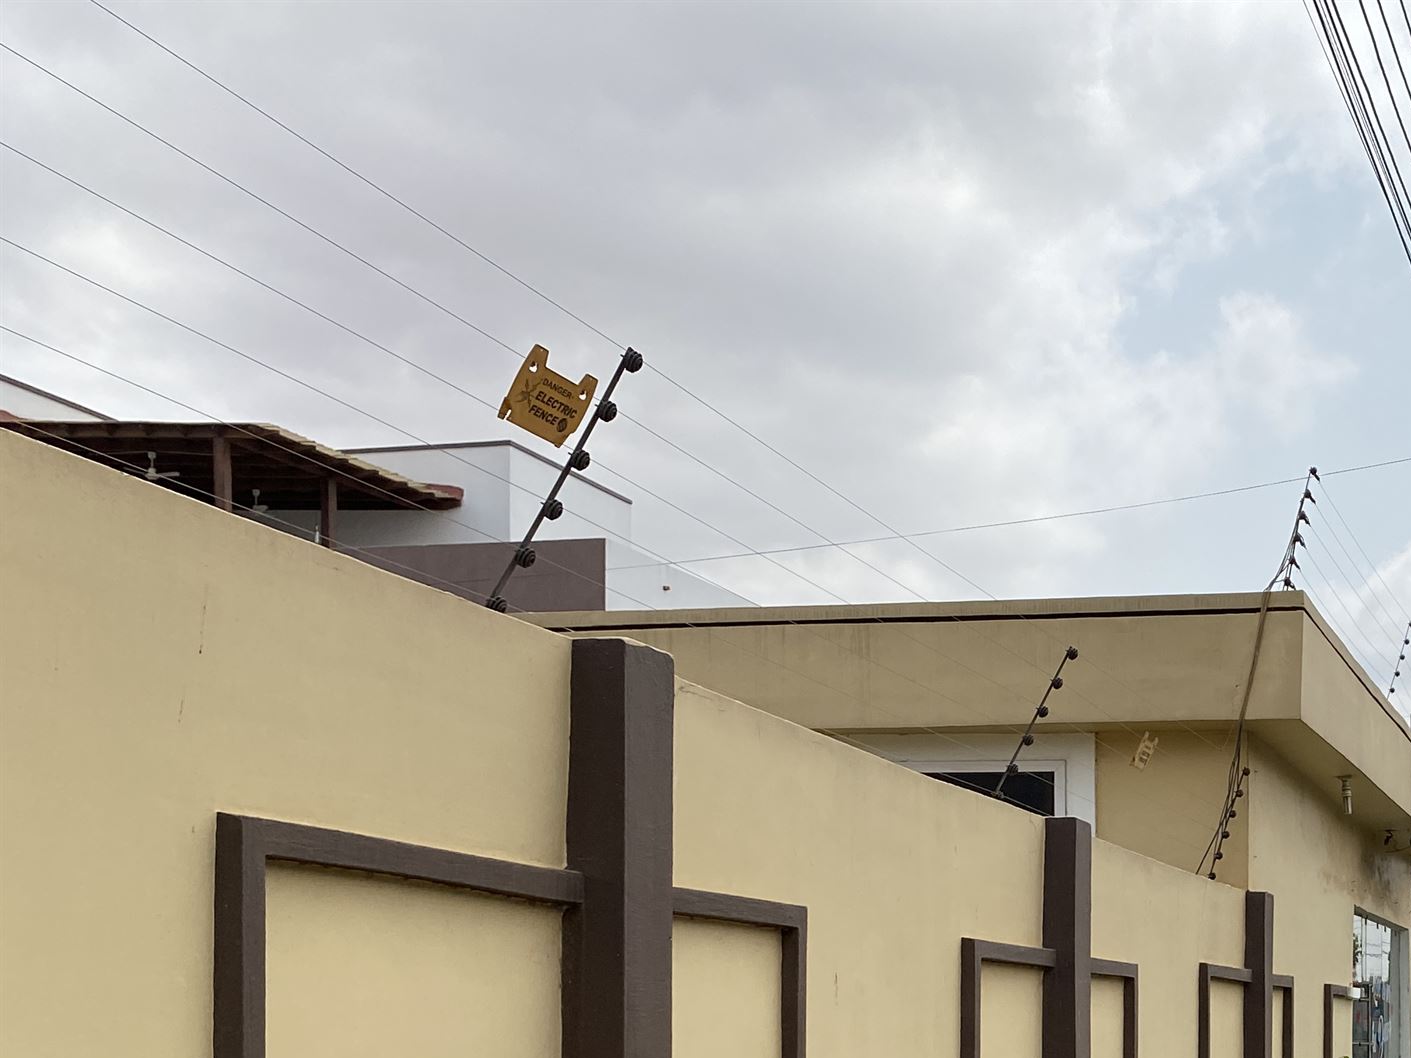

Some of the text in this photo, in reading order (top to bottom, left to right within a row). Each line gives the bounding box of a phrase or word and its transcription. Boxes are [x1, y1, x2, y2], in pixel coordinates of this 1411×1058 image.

[542, 378, 572, 399] DANGER
[528, 405, 559, 425] FENCE
[535, 390, 577, 419] ELECTRIC
